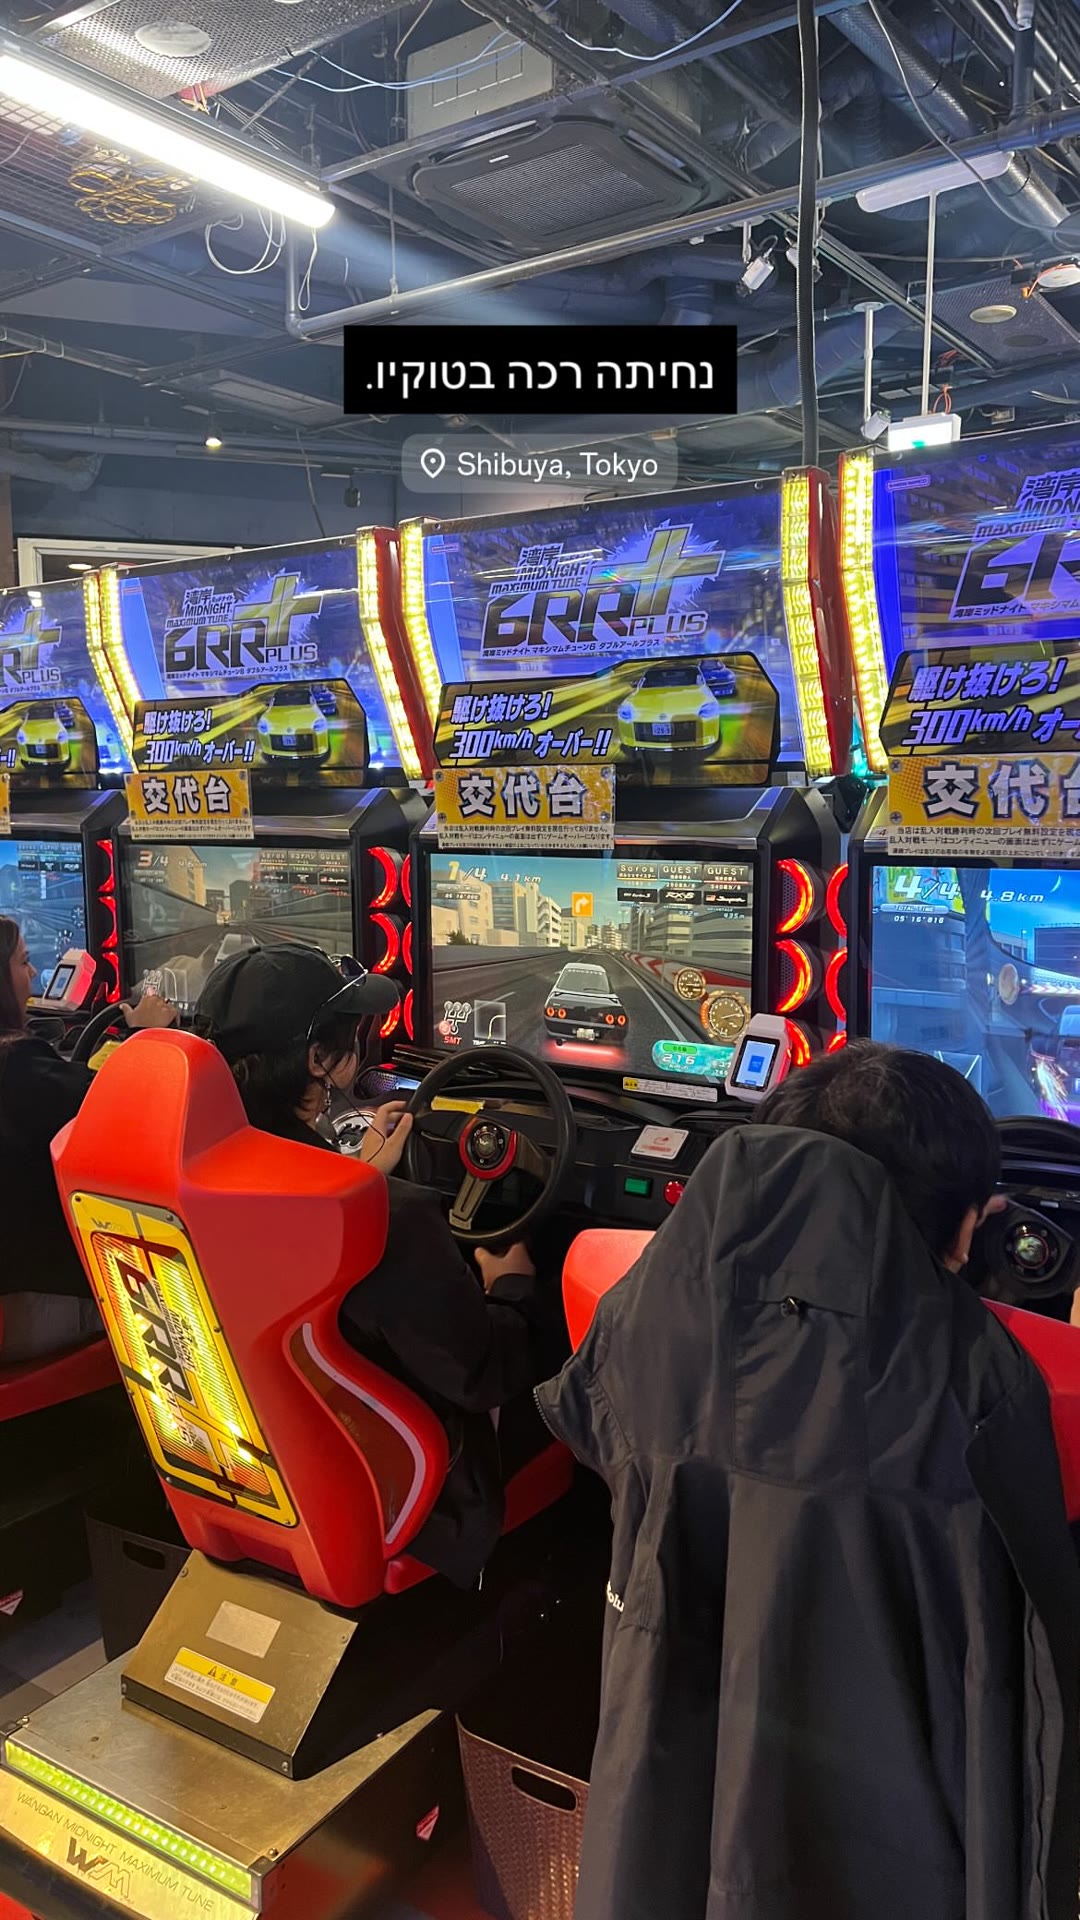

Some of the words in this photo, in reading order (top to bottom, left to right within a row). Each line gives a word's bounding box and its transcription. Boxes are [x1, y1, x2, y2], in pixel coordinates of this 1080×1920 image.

[184, 602, 233, 617] MIDNIGHT
[629, 612, 709, 638] PLUS
[265, 643, 318, 664] PLUS
[22, 668, 60, 684] PLUS
[1032, 707, 1080, 744] オー
[142, 776, 231, 813] 交代台
[459, 774, 587, 817] 交代台
[663, 865, 699, 875] GUEST
[707, 867, 745, 876] GUEST
[16, 1791, 63, 1825] WANGAN
[63, 1818, 118, 1855] MIDNIGHT
[119, 1852, 179, 1891] MAXIMUM
[183, 1885, 215, 1912] TUNE
